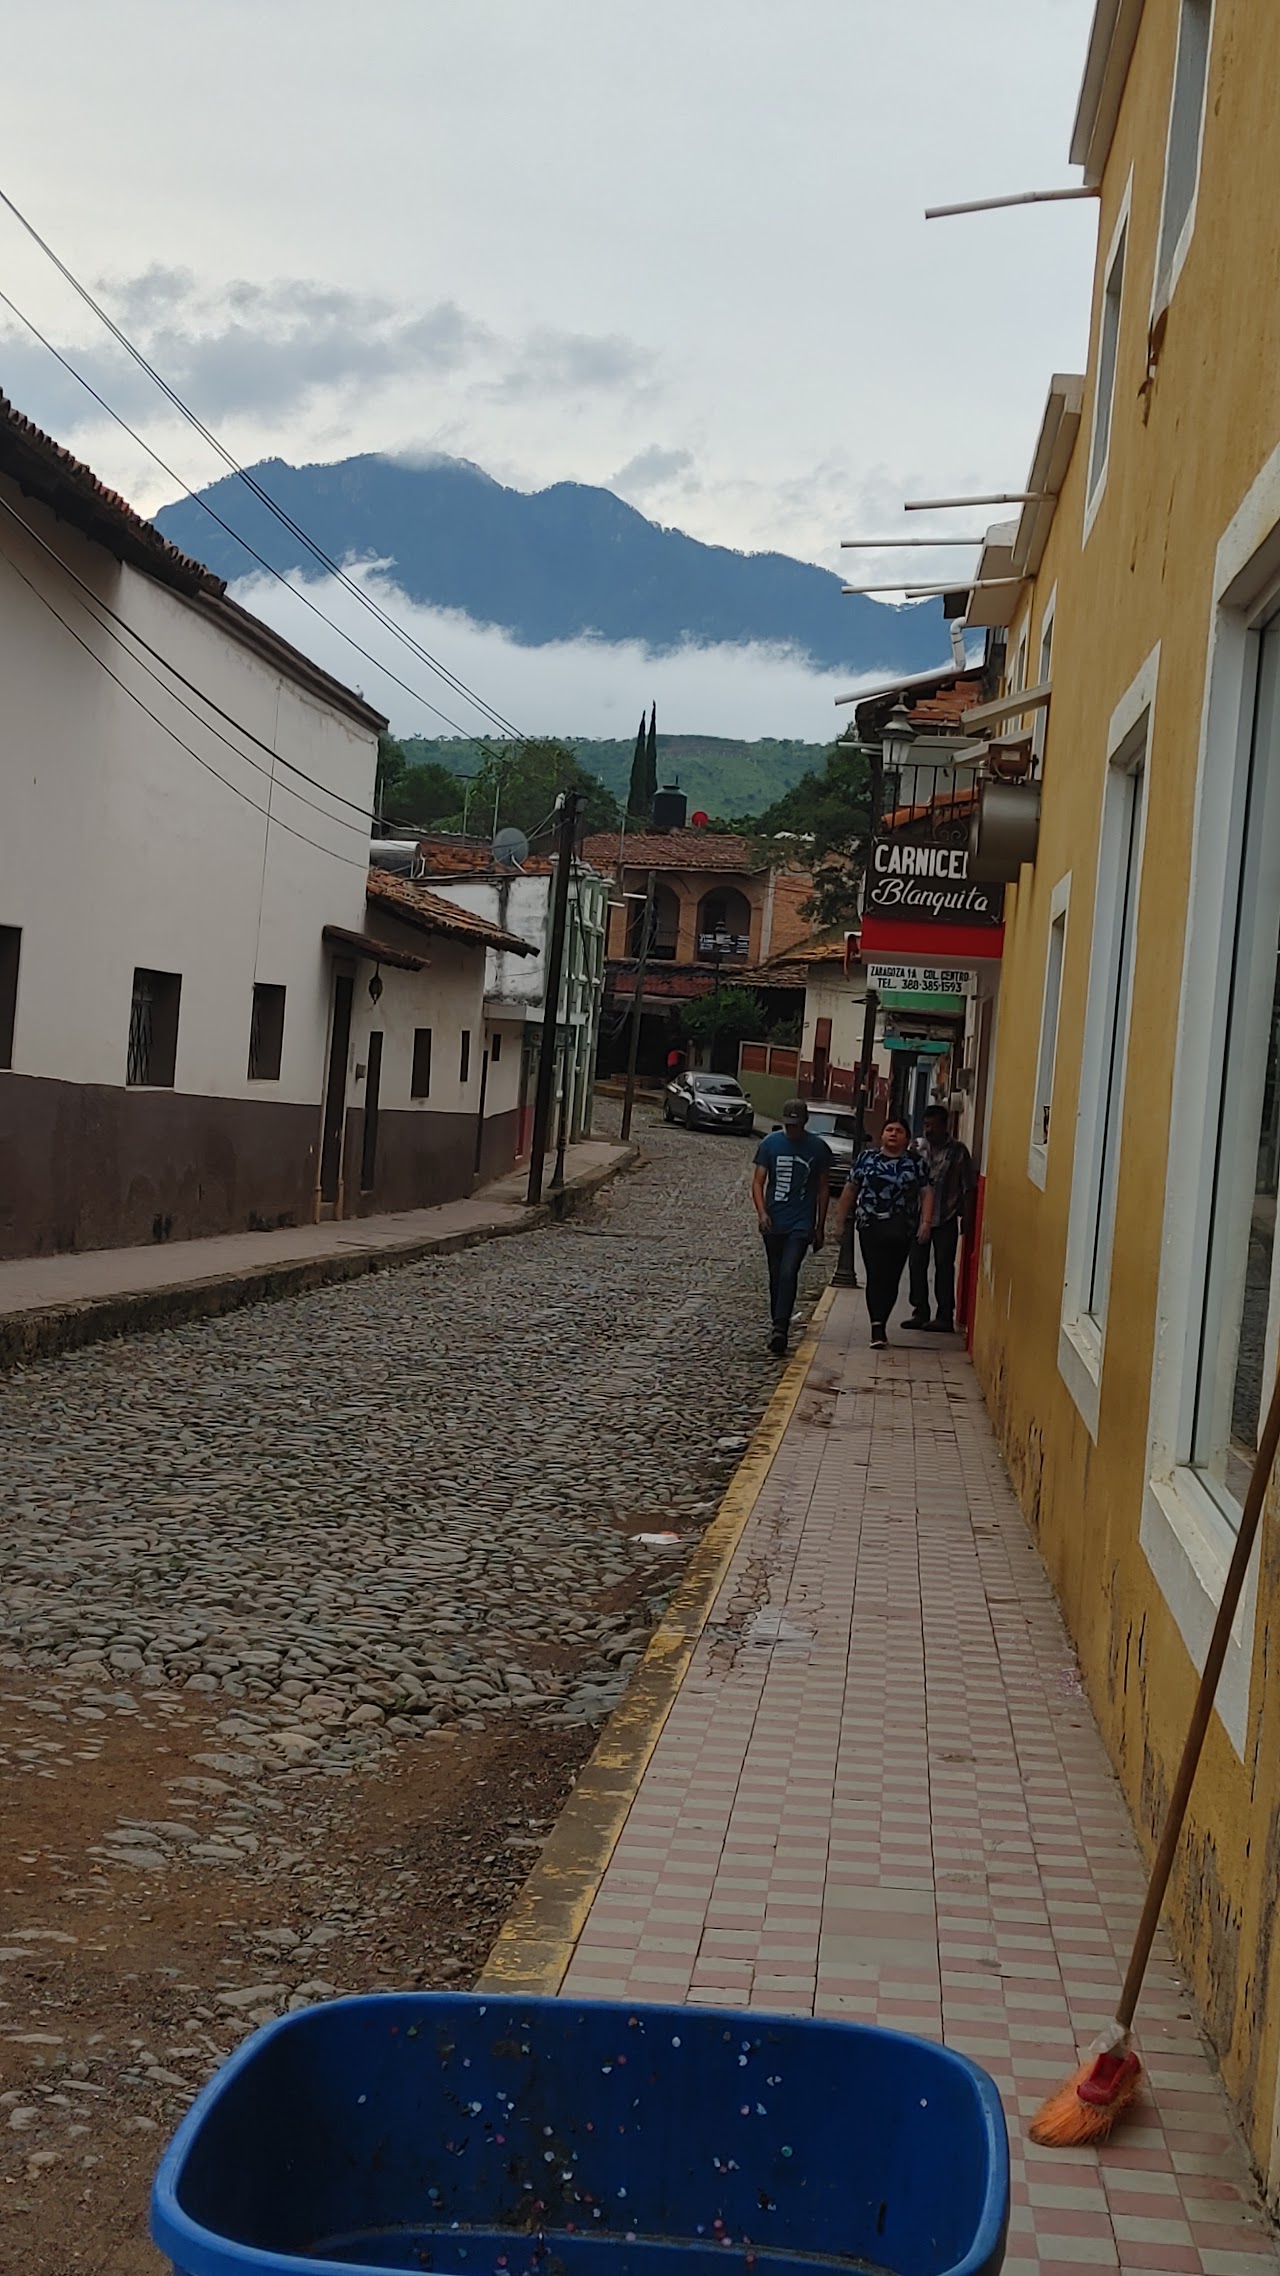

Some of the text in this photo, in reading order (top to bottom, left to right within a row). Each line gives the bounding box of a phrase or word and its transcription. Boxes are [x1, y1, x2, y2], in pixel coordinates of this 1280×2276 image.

[870, 878, 989, 916] Blanquita
[870, 965, 905, 978] ZARAGOZA
[774, 1156, 793, 1201] PUMA
